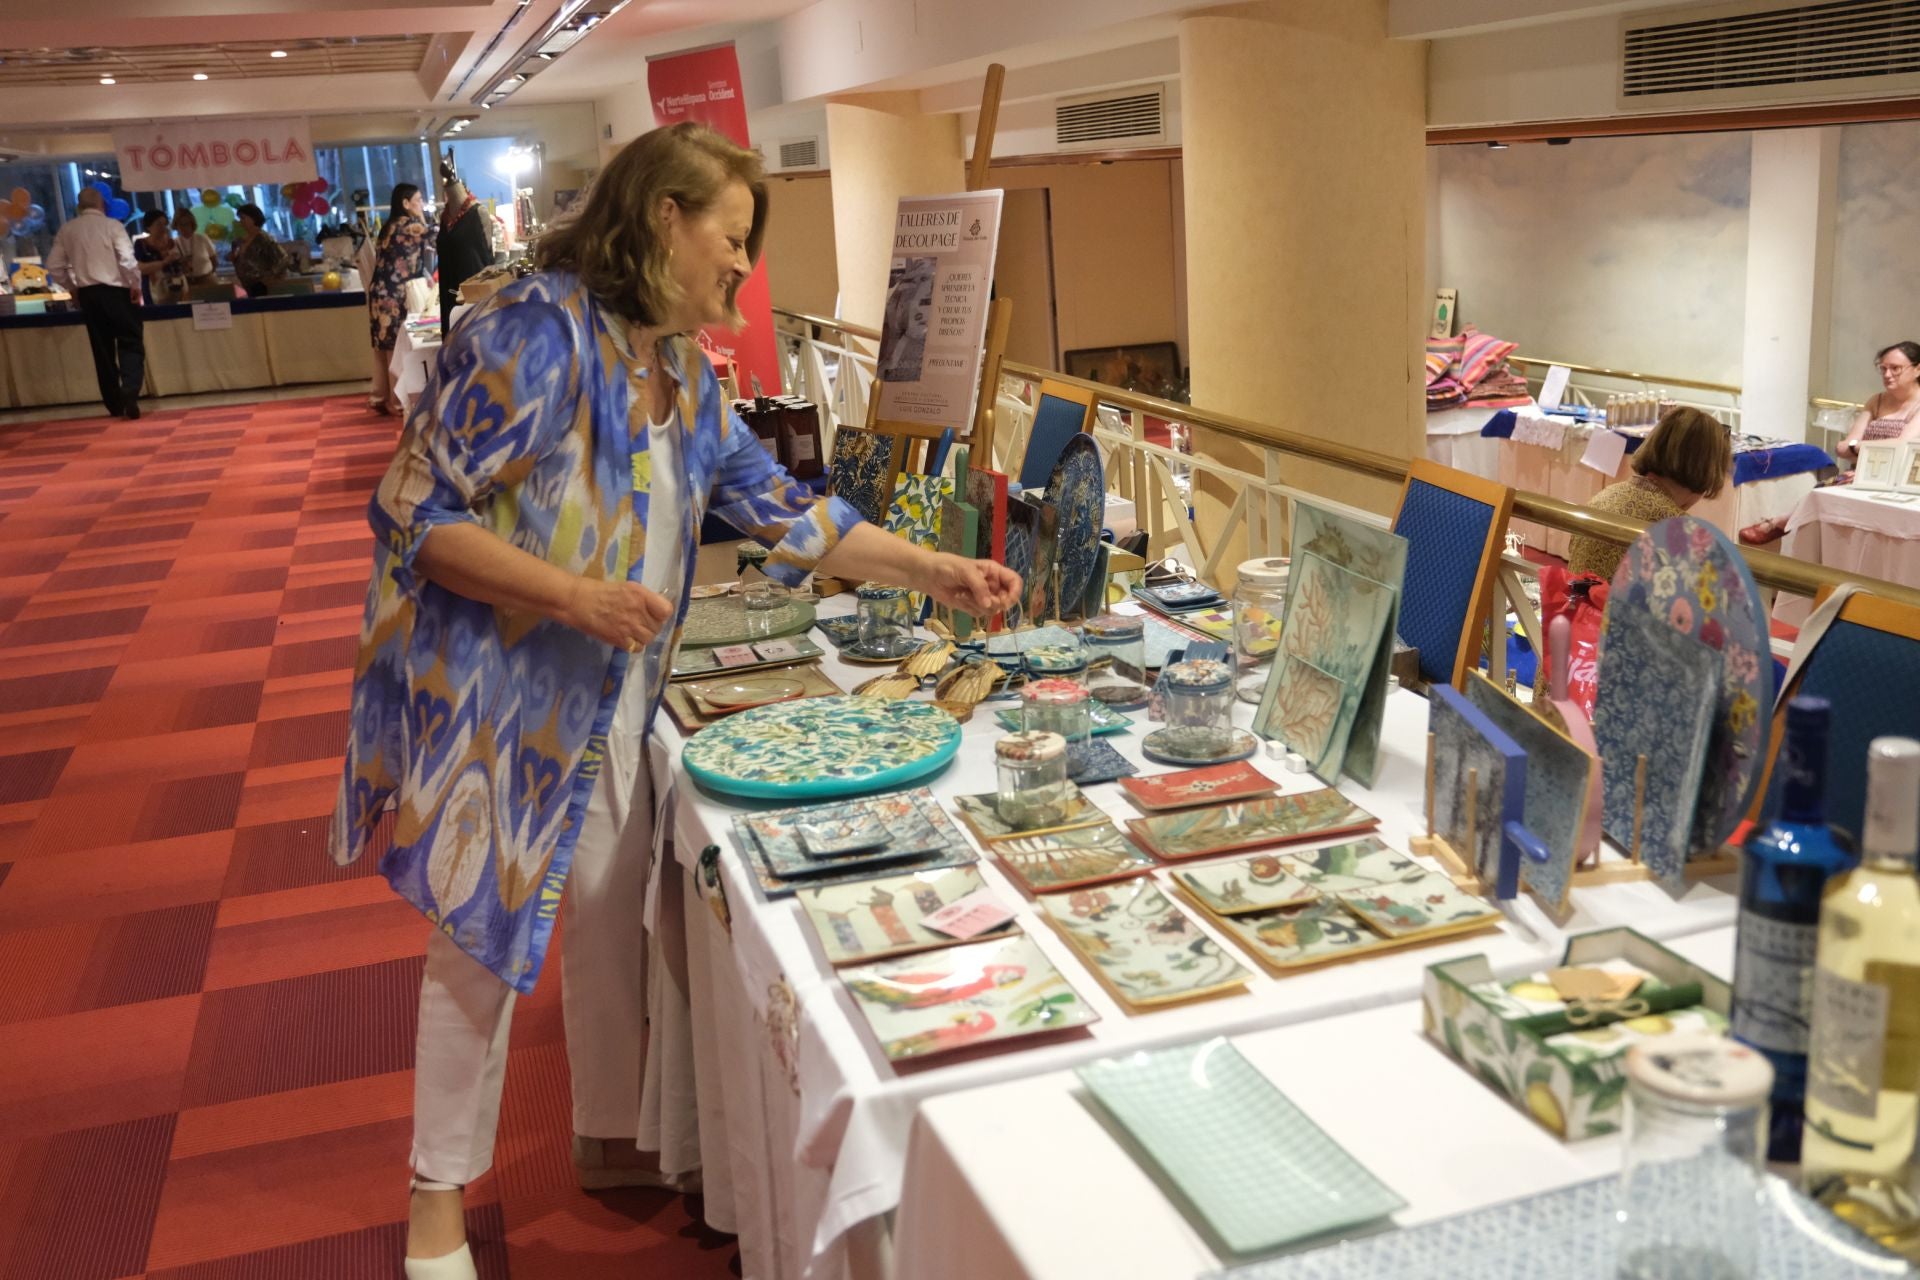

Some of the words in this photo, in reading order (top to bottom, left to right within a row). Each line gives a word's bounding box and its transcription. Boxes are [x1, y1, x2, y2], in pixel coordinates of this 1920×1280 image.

[708, 88, 735, 100] Occident
[123, 134, 307, 173] TÓMBOLA
[899, 213, 946, 228] TALLERES
[947, 211, 960, 226] DE
[895, 232, 958, 249] DECOUPAGE
[913, 406, 941, 415] GONZALO
